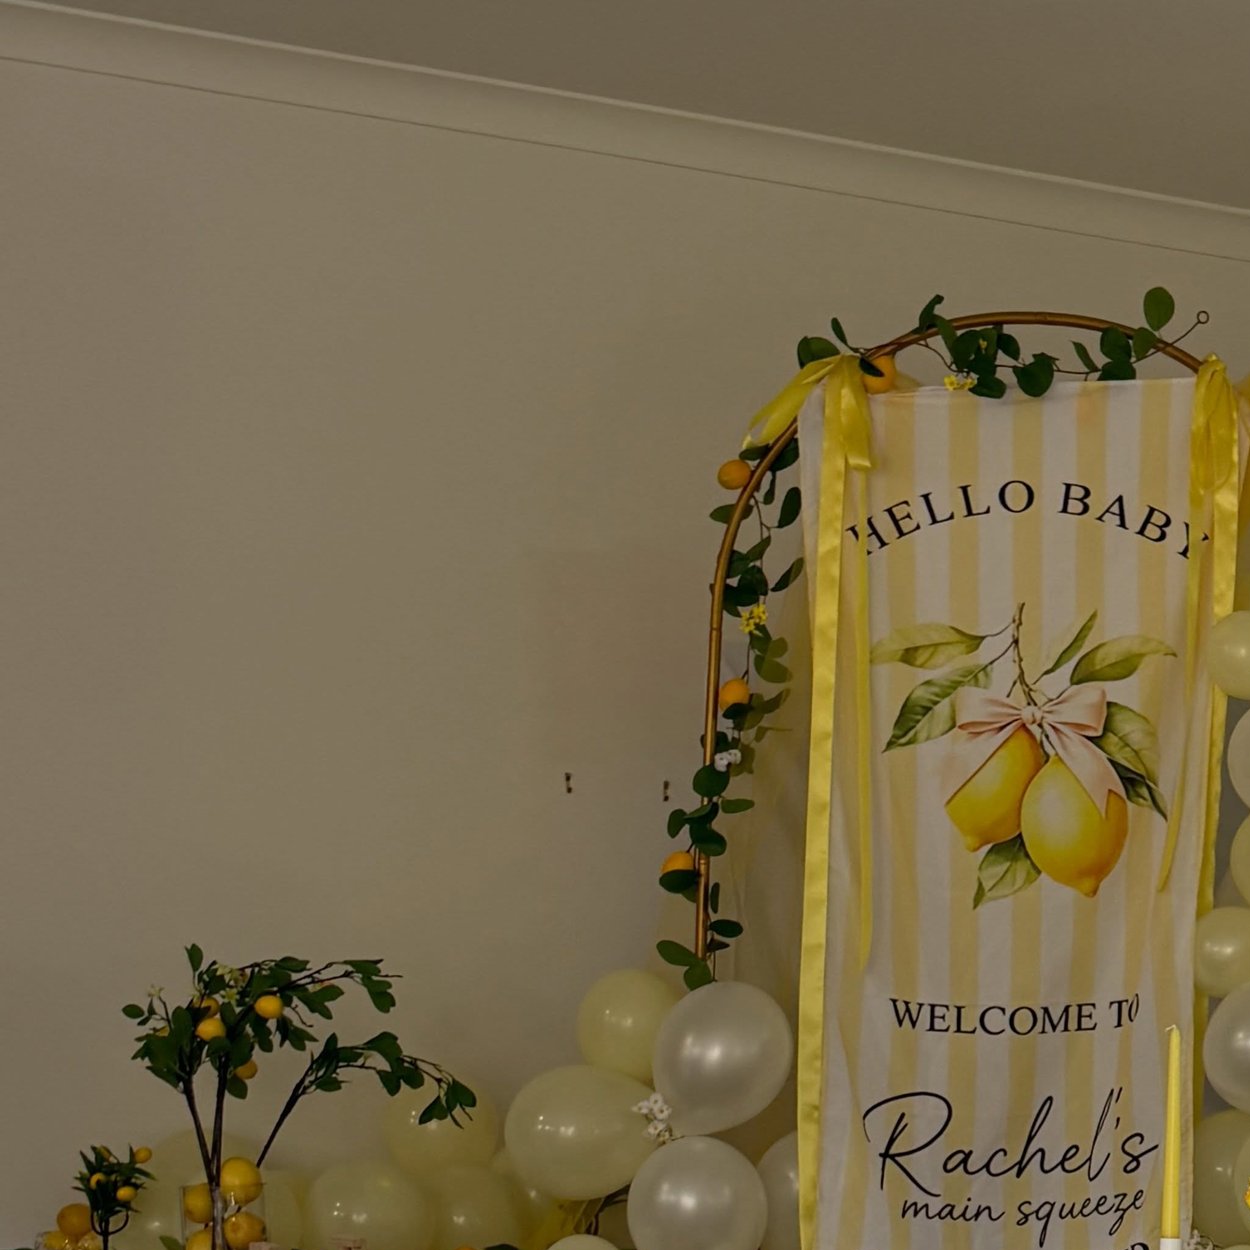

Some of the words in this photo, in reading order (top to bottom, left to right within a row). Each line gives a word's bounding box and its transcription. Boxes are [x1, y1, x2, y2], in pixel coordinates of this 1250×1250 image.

[845, 480, 1036, 556] HELLO
[889, 998, 1098, 1036] WELCOME
[1108, 992, 1141, 1029] TO
[862, 1086, 1160, 1198] Rachel's
[900, 1197, 1006, 1226] main
[1015, 1189, 1145, 1249] squeeze
